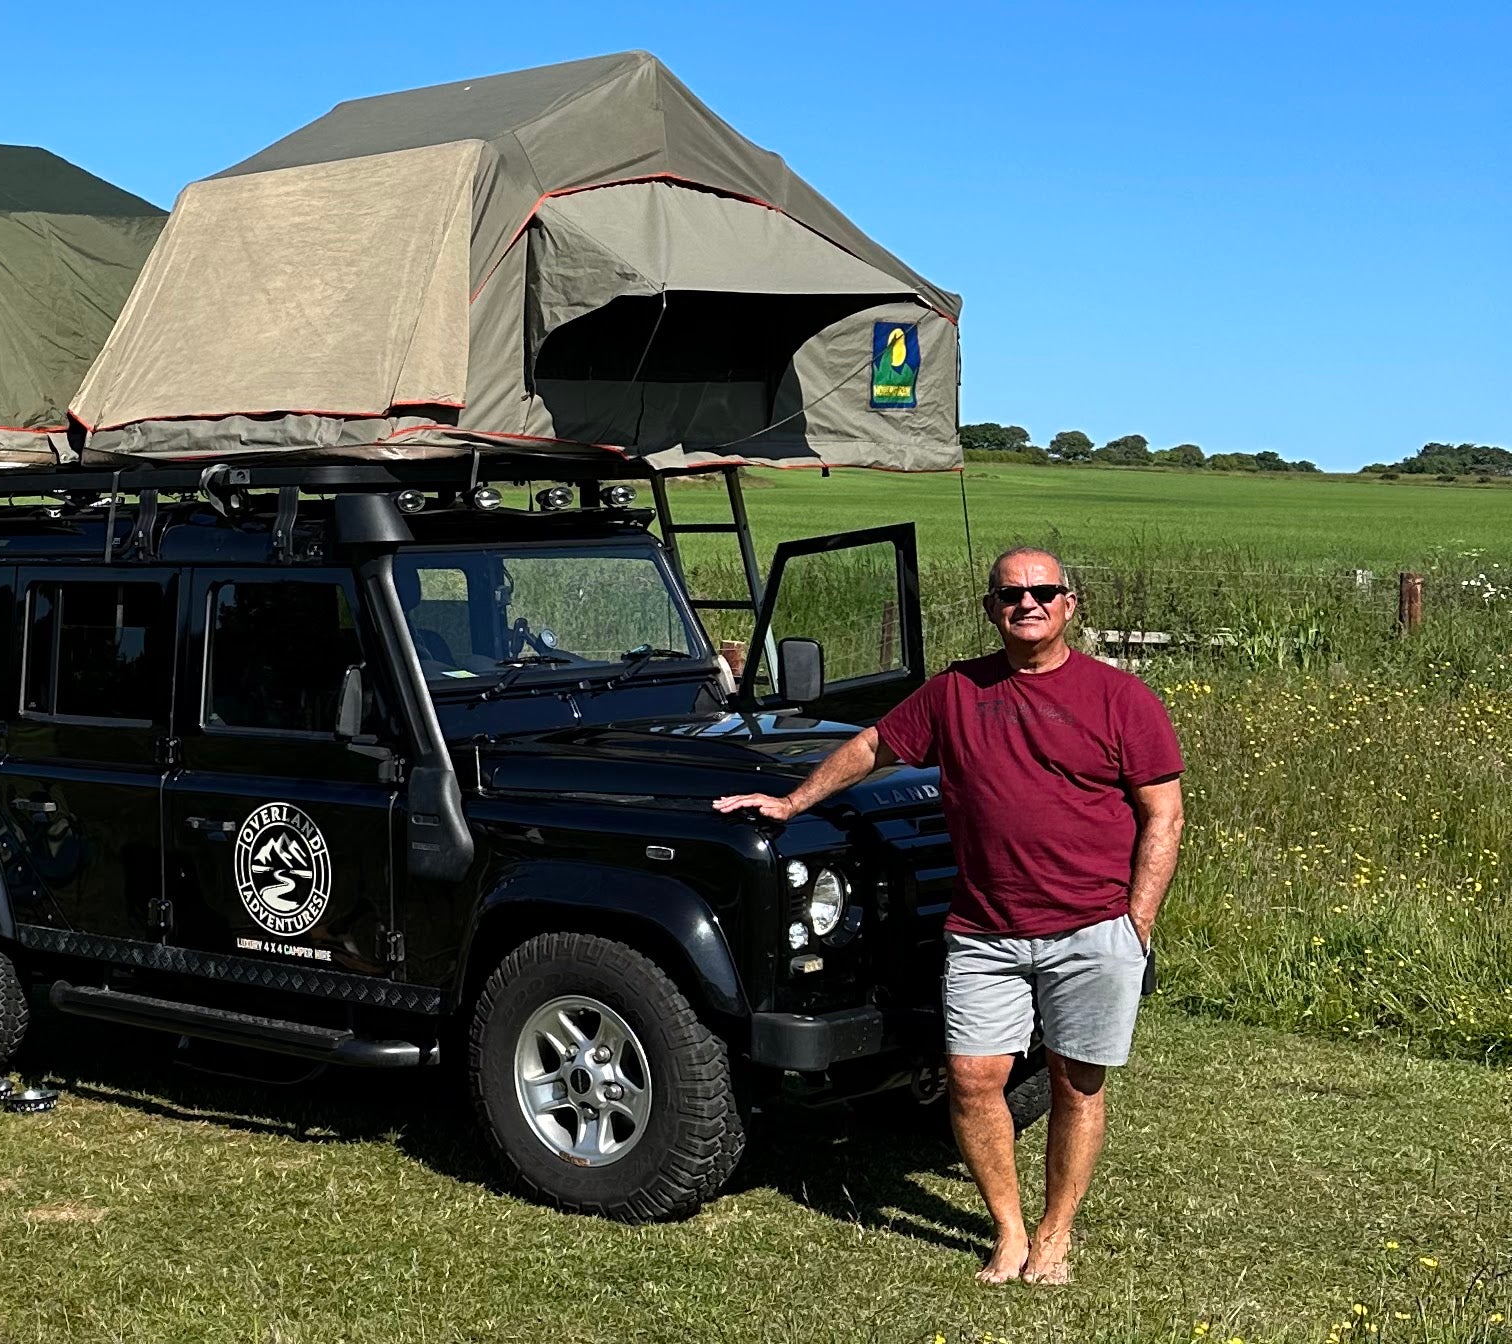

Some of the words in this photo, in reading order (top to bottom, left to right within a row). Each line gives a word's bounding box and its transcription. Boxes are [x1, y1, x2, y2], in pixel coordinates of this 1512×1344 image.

[873, 784, 939, 805] LAND
[243, 806, 322, 850] OVERLAND
[243, 890, 324, 932] ADVENTURES
[264, 942, 270, 952] 4
[277, 944, 283, 954] 4
[284, 944, 314, 959] CAMPER
